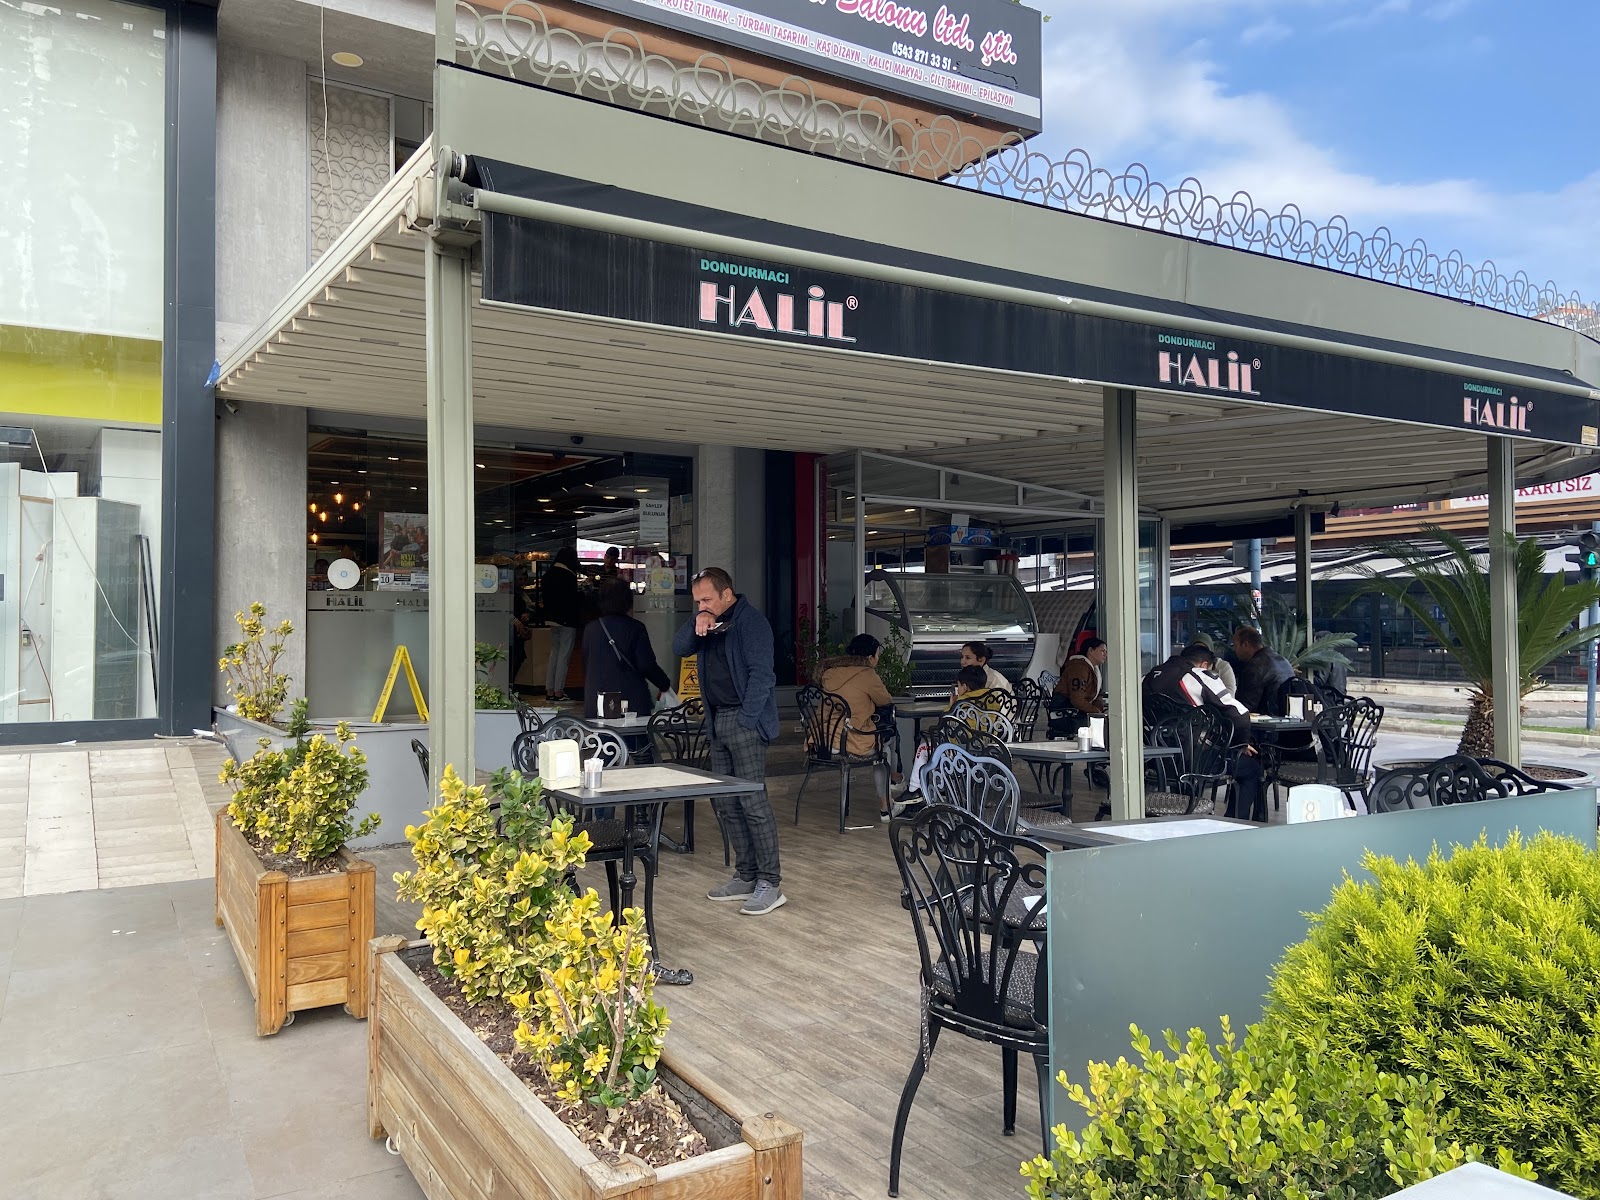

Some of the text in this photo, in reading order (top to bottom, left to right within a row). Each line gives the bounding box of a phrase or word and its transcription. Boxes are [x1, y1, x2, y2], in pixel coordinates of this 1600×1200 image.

[933, 5, 974, 51] ltd.
[980, 30, 1017, 66] şti.
[697, 3, 729, 24] TIRNAK
[737, 14, 771, 36] TÜRBAN
[773, 25, 809, 47] TASARIM
[816, 38, 832, 58] KAŞ
[833, 43, 861, 63] DİZAYN
[868, 54, 893, 74] KALICI
[894, 62, 924, 82] MAKYAJ
[930, 71, 946, 88] CİLT
[947, 76, 973, 95] BAKIMI
[979, 87, 1014, 107] EPİLASYON
[892, 41, 951, 70] 0543 871 33 51
[700, 259, 790, 284] DONDURMACI
[1158, 334, 1216, 351] DONDURMACI
[1463, 383, 1503, 396] DONDURMACI
